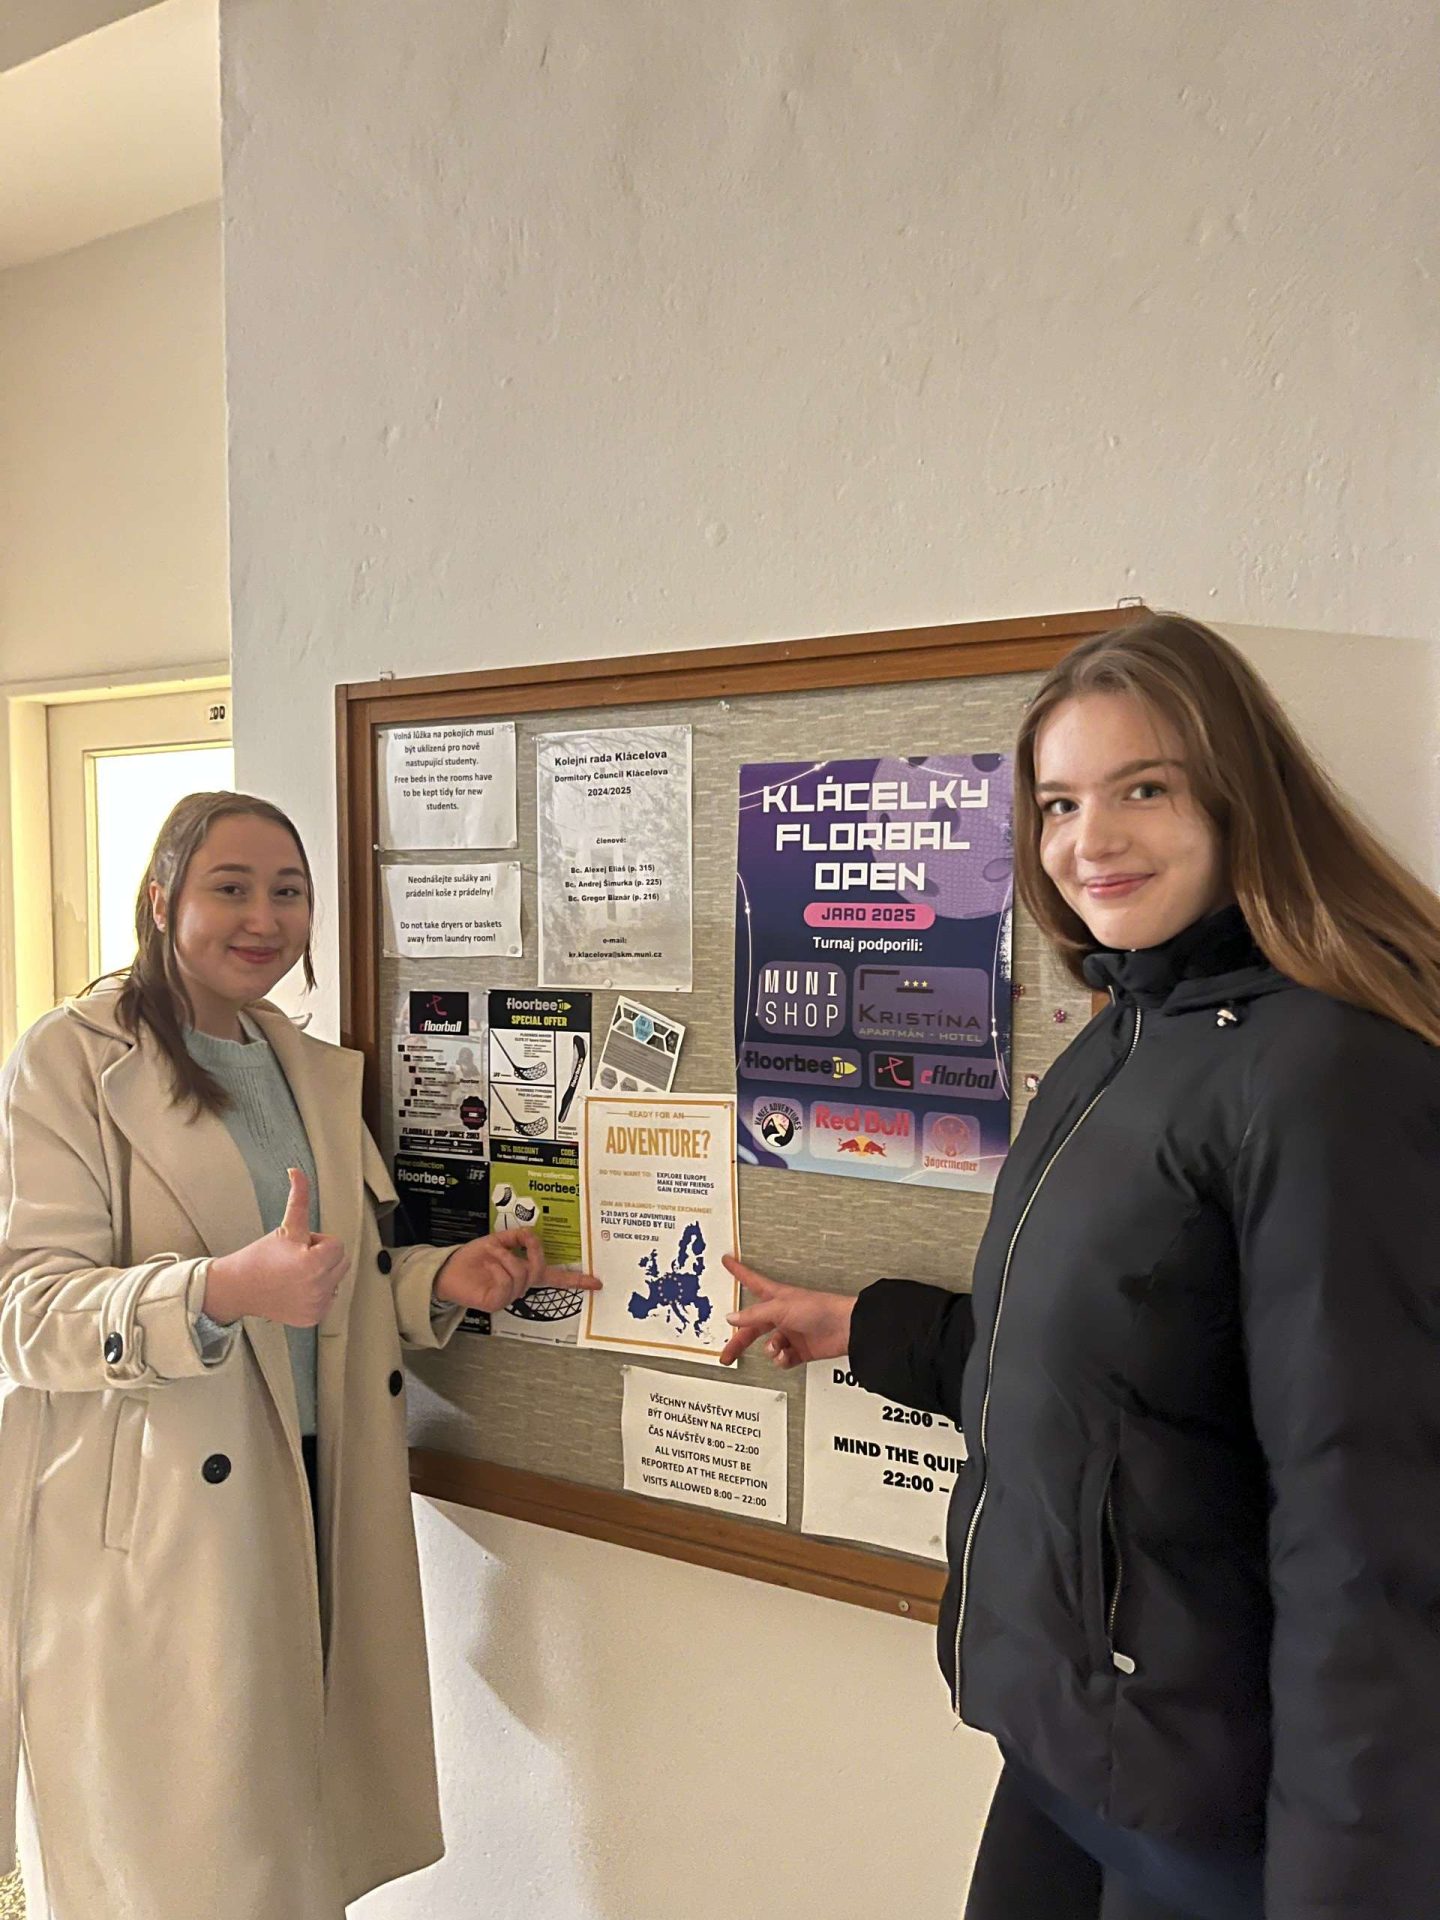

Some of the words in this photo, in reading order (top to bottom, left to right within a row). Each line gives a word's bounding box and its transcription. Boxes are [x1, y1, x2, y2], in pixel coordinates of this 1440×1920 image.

[394, 732, 411, 740] Volná
[443, 729, 474, 739] pokojích
[476, 728, 494, 736] musí
[405, 745, 416, 753] být
[448, 745, 460, 753] pro
[406, 760, 443, 768] nastupující
[445, 758, 478, 766] studenty.
[555, 756, 587, 767] Kolejní
[590, 754, 612, 763] rada
[615, 750, 667, 762] Klácelova
[411, 774, 426, 782] beds
[428, 774, 435, 782] in
[475, 773, 492, 781] have
[555, 773, 591, 782] Dormitory
[594, 771, 624, 780] Council
[626, 768, 668, 777] Klácelova
[412, 788, 420, 796] be
[422, 788, 438, 797] kept
[440, 788, 453, 797] tidy
[588, 786, 631, 796] 2024/2025
[763, 776, 989, 813] KLÁCELKY
[426, 802, 459, 810] students.
[776, 821, 971, 851] FLORBAL
[584, 866, 607, 874] Alexej
[628, 865, 637, 873] (p.
[639, 864, 655, 872] 315)
[408, 875, 452, 884] Neodnášejte
[454, 874, 478, 883] sušáky
[480, 873, 491, 881] ani
[603, 879, 633, 887] Šimurka
[634, 879, 644, 887] (p.
[814, 862, 926, 891] OPEN
[436, 888, 452, 896] koše
[459, 887, 494, 898] prádelny!
[581, 895, 606, 903] Gregor
[632, 894, 641, 902] (p.
[643, 893, 660, 901] 216)
[821, 907, 867, 921] JARO
[871, 908, 916, 922] 2025
[441, 921, 463, 930] dryers
[474, 920, 502, 928] baskets
[408, 936, 425, 944] away
[426, 934, 443, 942] from
[445, 934, 472, 943] laundry
[474, 934, 496, 942] room!
[813, 936, 854, 952] Turnaj
[858, 938, 923, 953] podporili:
[764, 969, 838, 996] MUNI
[506, 998, 558, 1011] floorbee
[511, 1015, 542, 1025] SPECIAL
[543, 1016, 567, 1026] OFFER
[765, 1001, 839, 1028] SHOP
[859, 1027, 924, 1039] APARTMÁN
[939, 1032, 983, 1042] HOTEL
[744, 1050, 833, 1074] floorbee
[754, 1107, 769, 1126] VANEE
[769, 1102, 802, 1131] ADVENTURES
[815, 1103, 861, 1132] Red
[864, 1110, 910, 1137] Bull
[606, 1126, 711, 1159] ADVENTURE?
[513, 1146, 539, 1155] DISCOUNT
[398, 1169, 446, 1185] floorbee
[657, 1172, 682, 1180] EXPLORE
[684, 1173, 706, 1181] EUROPE
[529, 1180, 576, 1194] floorbee
[673, 1187, 708, 1195] EXPERIENCE
[601, 1217, 620, 1225] FULLY
[623, 1218, 651, 1227] FUNDED
[653, 1221, 661, 1229] BY
[640, 1213, 676, 1221] ADVENTURES
[613, 1231, 632, 1240] CHECK
[650, 1393, 686, 1408] VŠECHNY
[688, 1401, 733, 1418] NÁVŠTĚVY
[735, 1410, 760, 1422] MUSÍ
[648, 1407, 662, 1416] BÝT
[664, 1412, 708, 1428] OHLÁŠENY
[710, 1421, 723, 1431] NA
[725, 1424, 761, 1438] RECEPCI
[882, 1406, 933, 1428] 22:00
[648, 1425, 664, 1437] ČAS
[666, 1429, 705, 1444] NÁVŠTĚV
[707, 1438, 725, 1449] 8:00
[734, 1443, 759, 1455] 22:00
[834, 1436, 880, 1457] MIND
[885, 1445, 919, 1465] THE
[655, 1446, 669, 1456] ALL
[671, 1448, 711, 1463] VISITORS
[712, 1456, 738, 1468] MUST
[740, 1462, 751, 1471] BE
[641, 1457, 684, 1473] REPORTED
[686, 1466, 698, 1475] AT
[700, 1469, 716, 1479] THE
[718, 1472, 768, 1490] RECEPTION
[883, 1470, 934, 1492] 22:00
[643, 1474, 668, 1487] VISITS
[670, 1479, 712, 1495] ALLOWED
[714, 1489, 732, 1500] 8:00
[742, 1495, 767, 1507] 22:00
